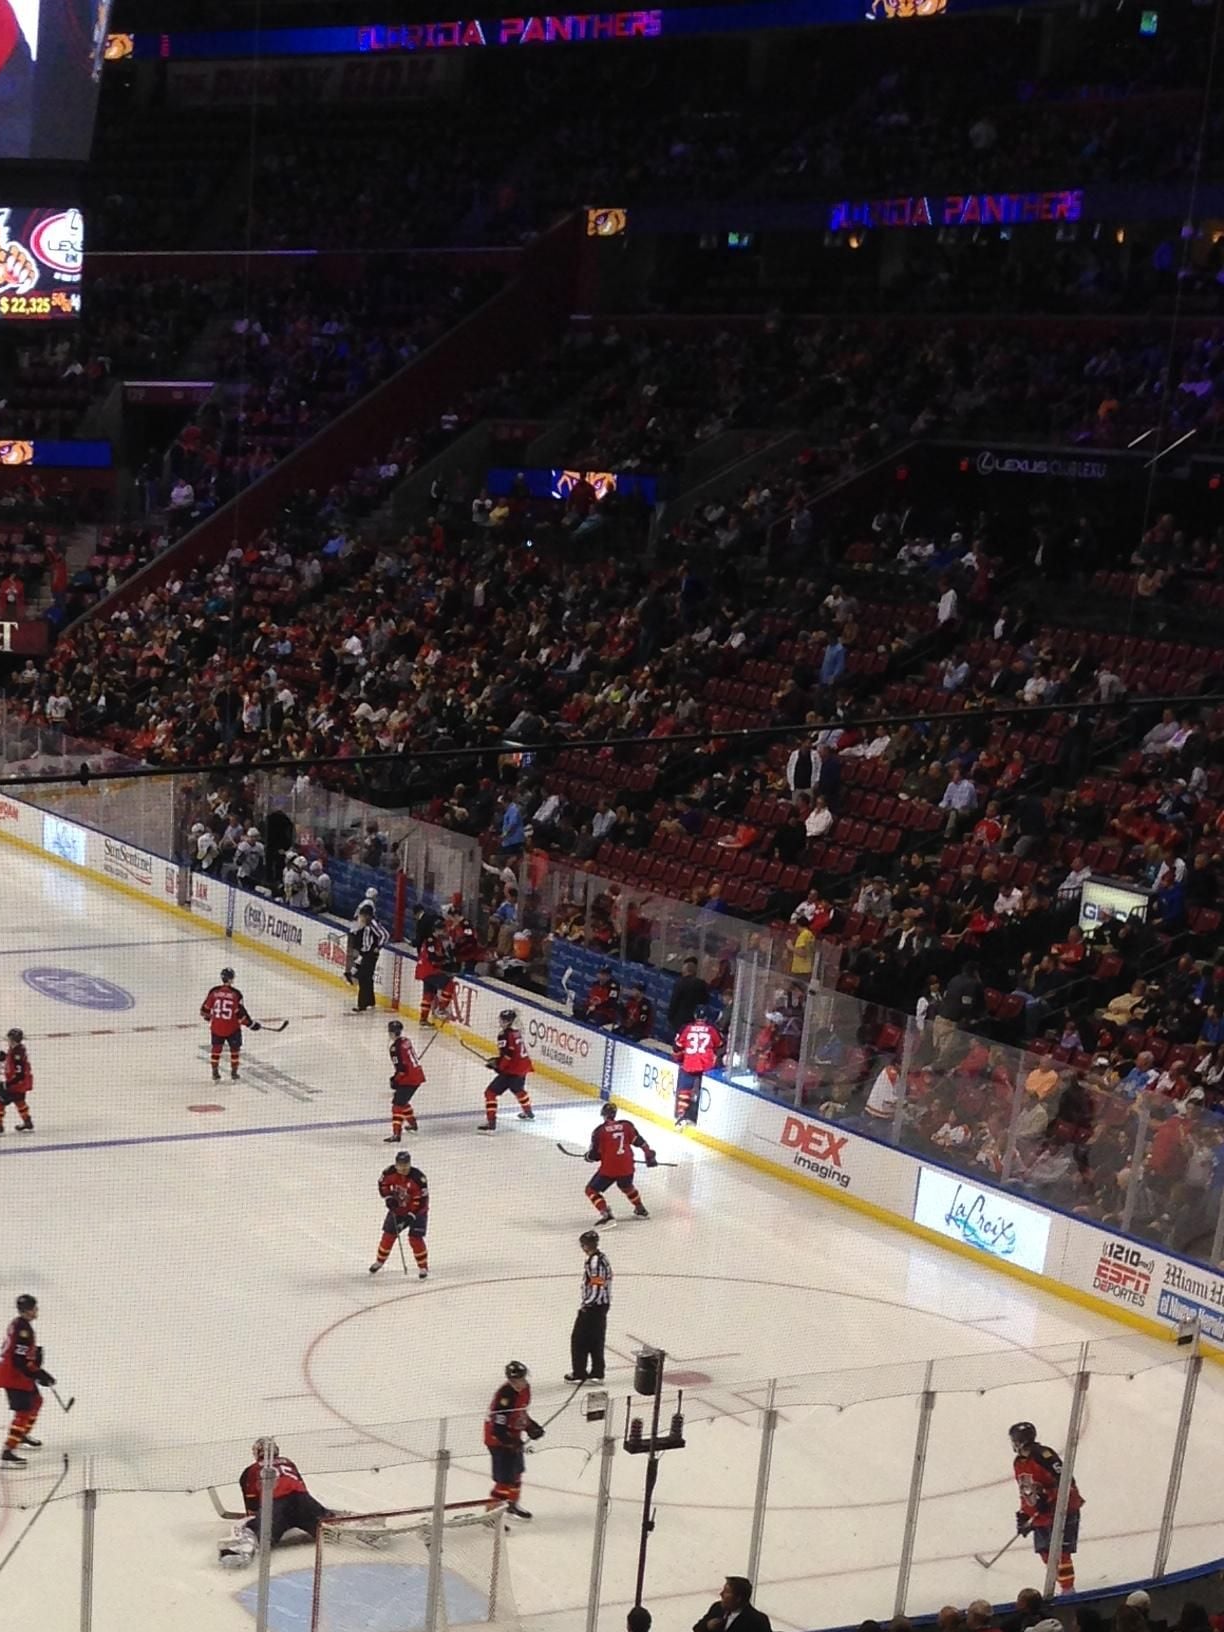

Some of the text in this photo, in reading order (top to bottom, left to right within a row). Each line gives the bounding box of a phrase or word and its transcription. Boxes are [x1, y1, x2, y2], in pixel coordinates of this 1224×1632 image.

[500, 10, 662, 44] PANTHERS
[265, 915, 303, 946] FLORIDA
[529, 1019, 589, 1057] gomacro
[685, 1032, 711, 1055] 37
[779, 1115, 849, 1167] DEX
[792, 1151, 852, 1189] imaging
[1108, 1242, 1142, 1268] 1210
[1092, 1276, 1146, 1308] DEPORTES
[1096, 1256, 1152, 1295] ESPN
[1162, 1262, 1209, 1300] Miami
